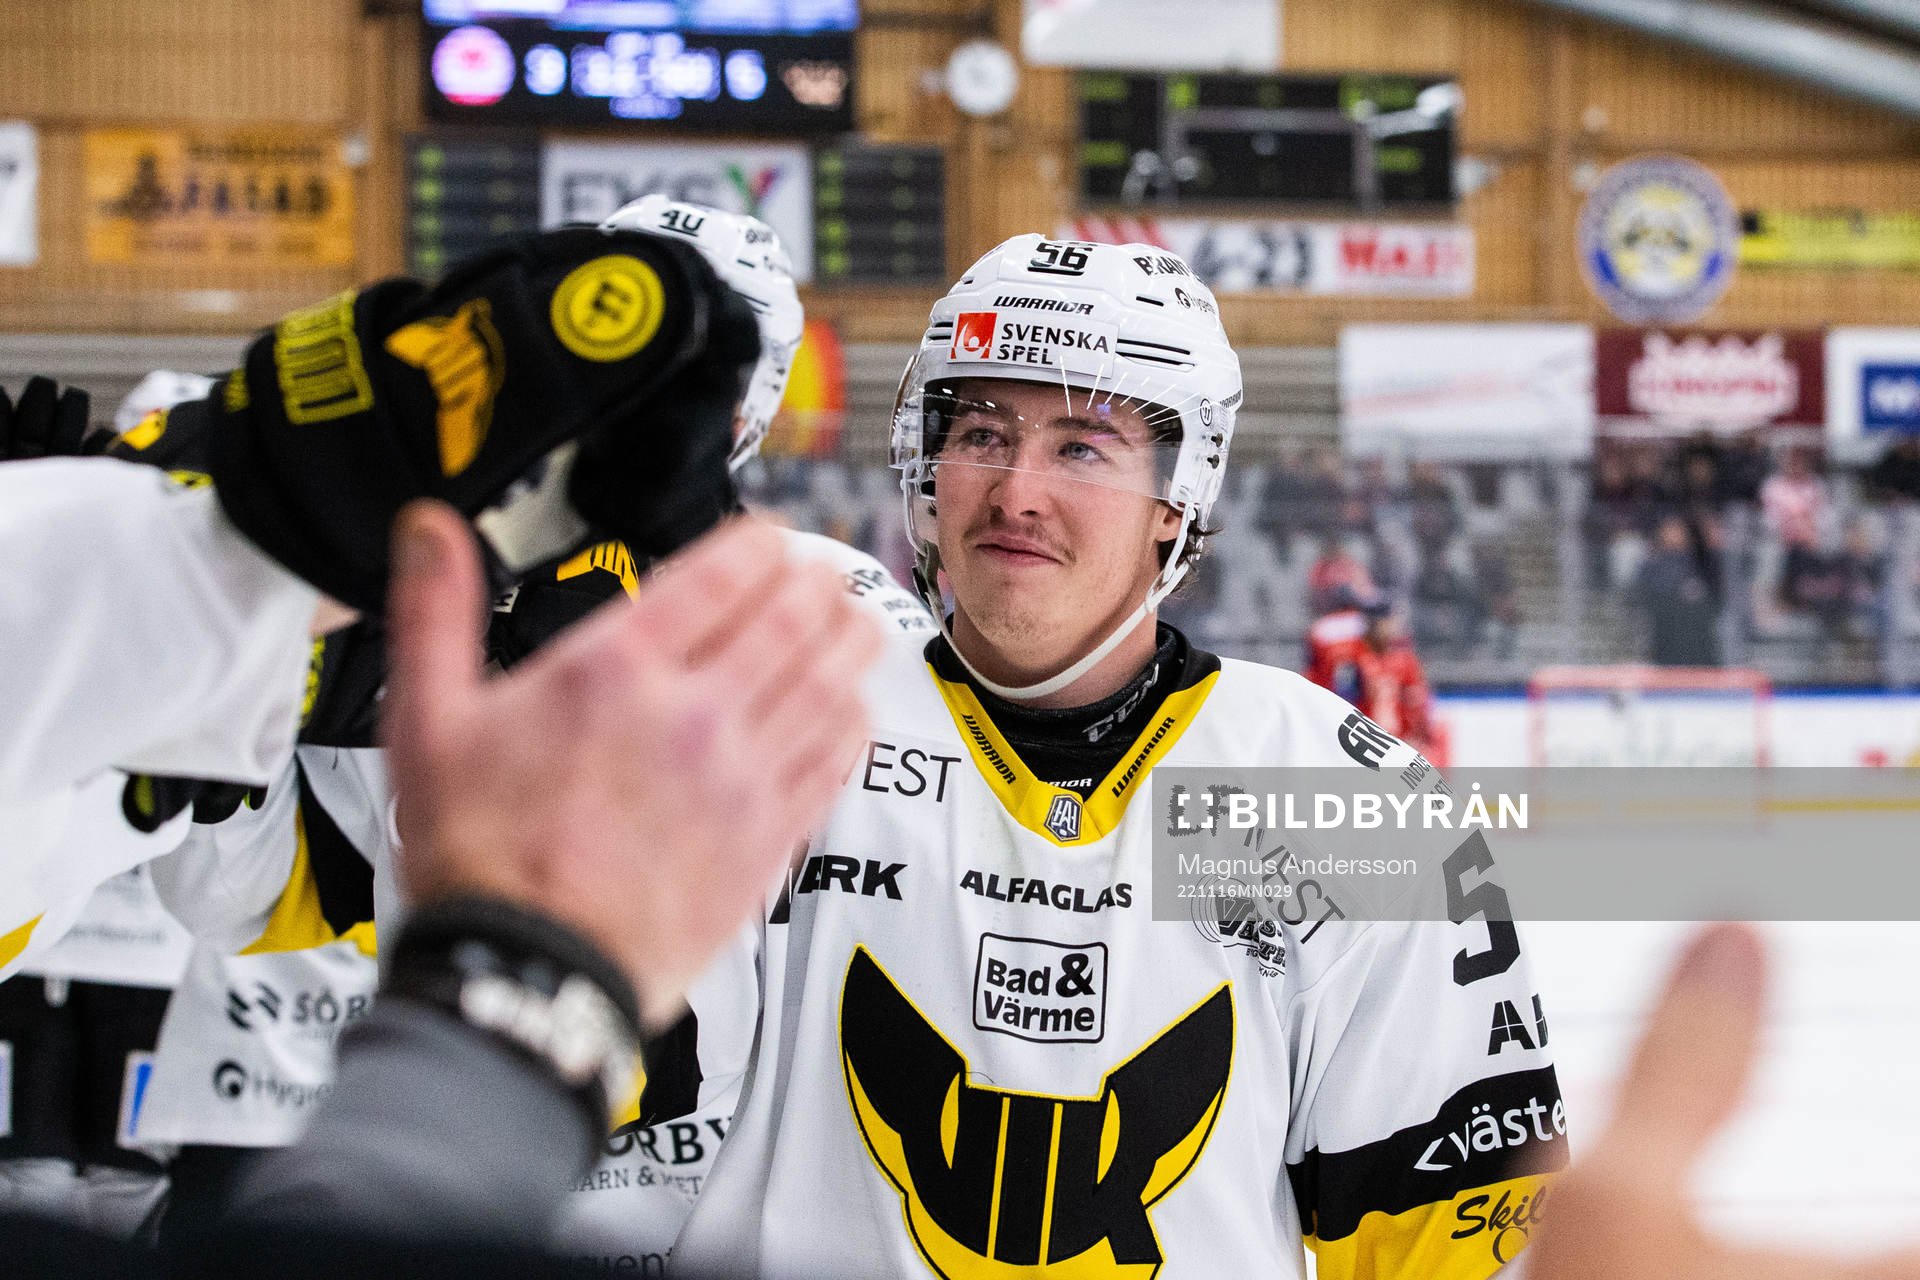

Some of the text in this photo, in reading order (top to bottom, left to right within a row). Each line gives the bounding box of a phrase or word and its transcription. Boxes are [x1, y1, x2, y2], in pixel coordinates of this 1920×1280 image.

[1030, 242, 1093, 271] 56
[993, 296, 1094, 315] WARRIOR
[997, 344, 1053, 366] SPEL
[1001, 323, 1109, 354] SVENSKA
[962, 713, 1017, 785] WARRIOR
[1112, 716, 1176, 798] WARRIOR
[862, 740, 962, 803] EST
[960, 869, 1132, 913] ALFAGLAS
[984, 991, 1095, 1033] Värme
